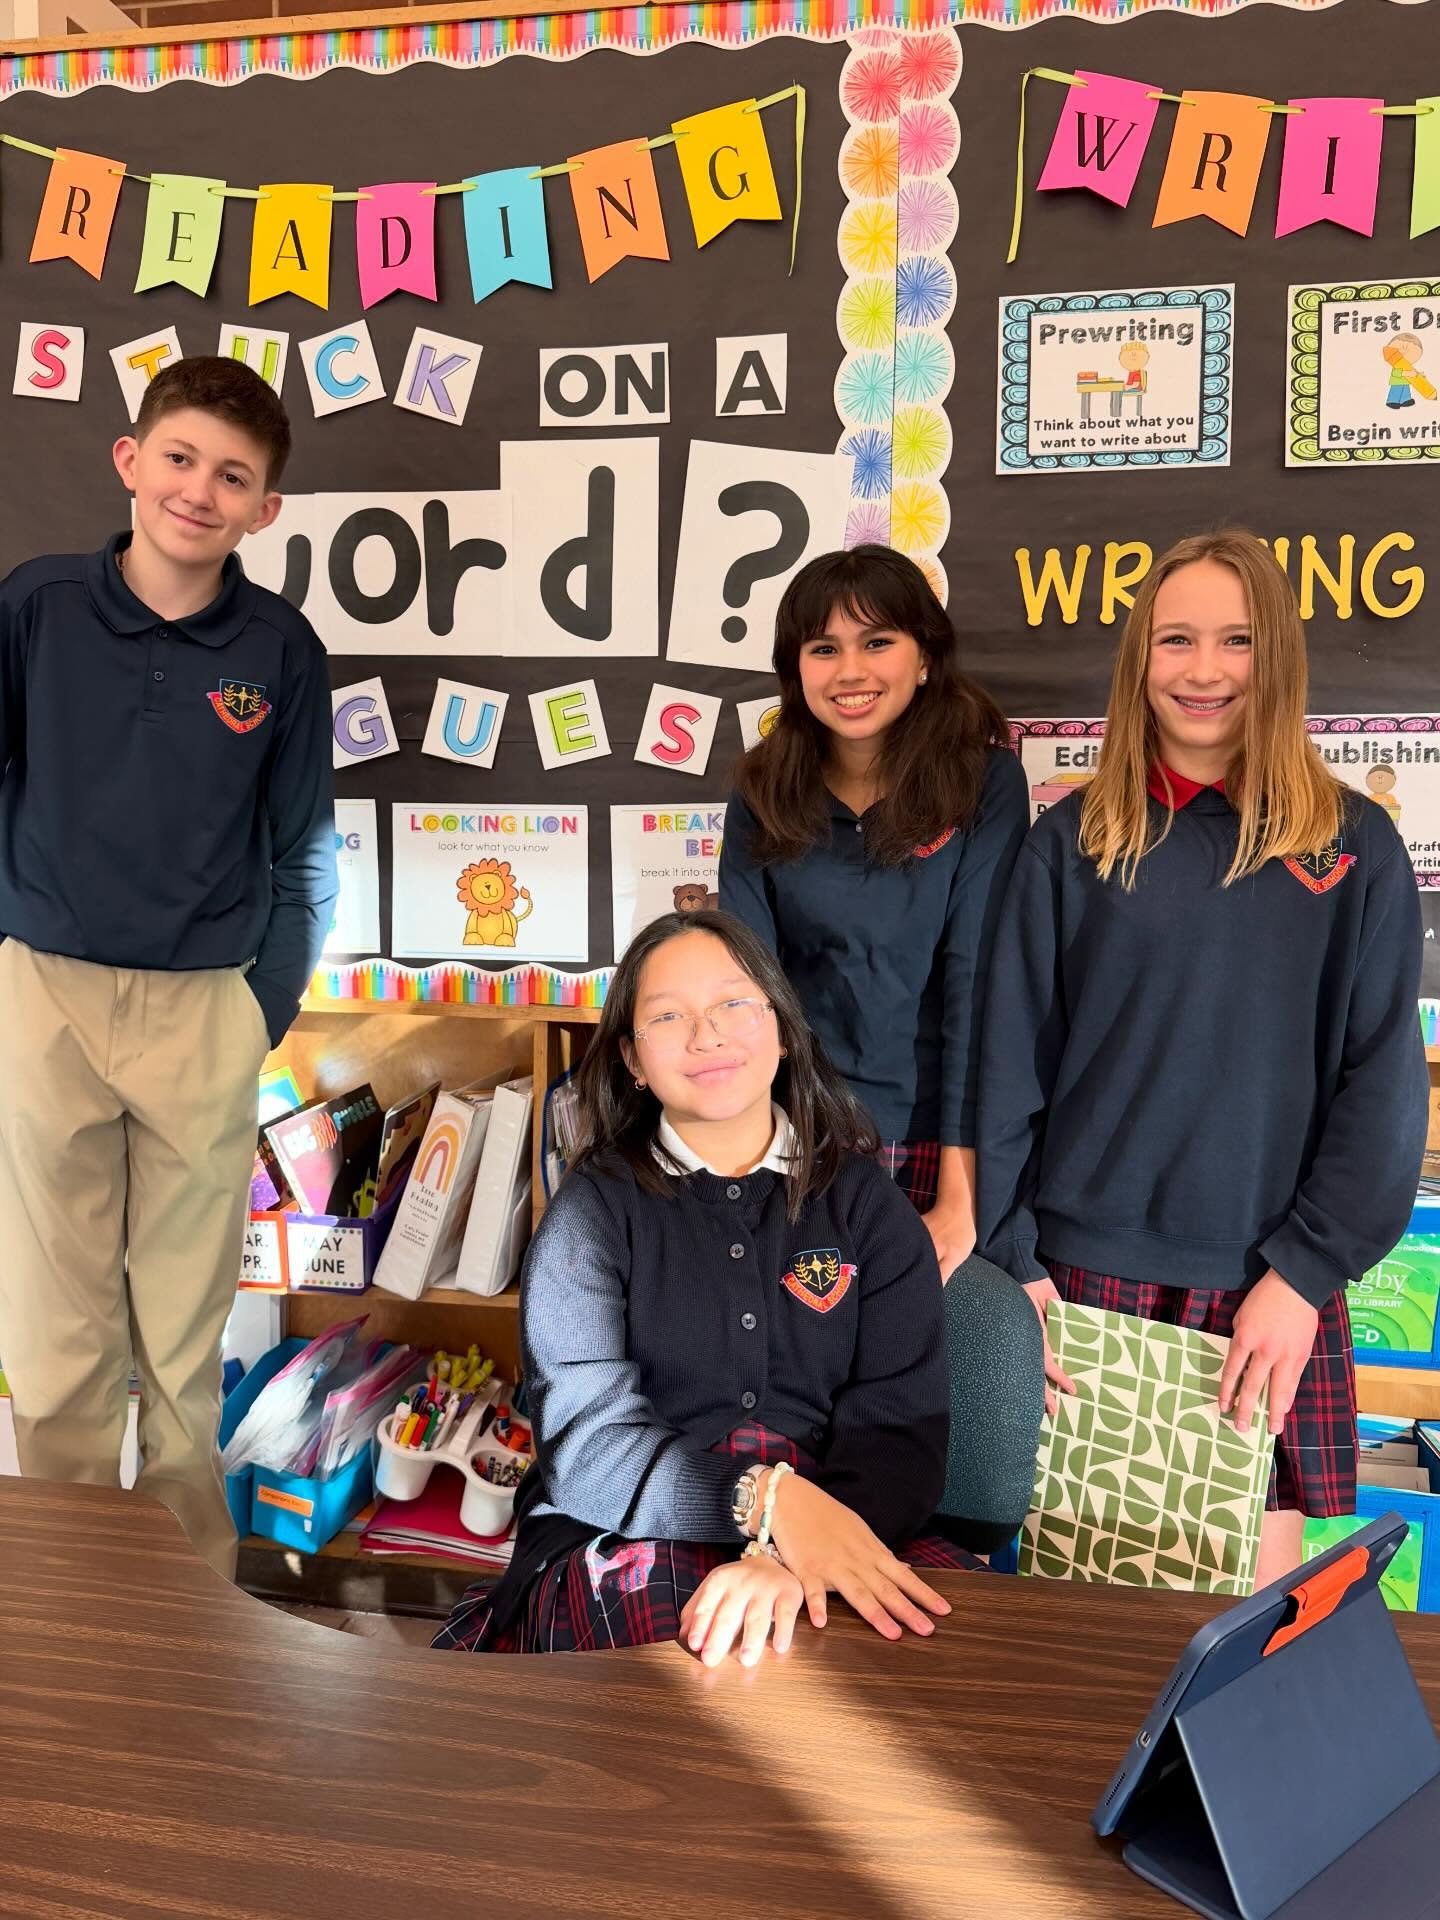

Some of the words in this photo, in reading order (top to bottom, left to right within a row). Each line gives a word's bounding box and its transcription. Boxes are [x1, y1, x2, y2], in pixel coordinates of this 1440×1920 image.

[59, 147, 749, 271] READING
[1039, 317, 1194, 346] Prewriting
[1333, 310, 1402, 335] First
[544, 351, 666, 418] ON
[719, 350, 784, 414] A
[1034, 418, 1074, 431] Think
[1079, 417, 1121, 430] about
[1126, 415, 1162, 428] what
[1167, 416, 1194, 429] you
[1040, 437, 1076, 449] want
[1081, 436, 1096, 447] to
[1101, 434, 1140, 447] write
[1144, 432, 1187, 446] about
[1328, 423, 1392, 446] Begin
[410, 814, 518, 834] LOOKING
[524, 815, 578, 834] LION
[438, 841, 458, 851] look
[461, 842, 473, 851] for
[475, 842, 500, 852] what
[502, 843, 521, 854] you
[523, 843, 549, 853] know
[641, 868, 671, 878] break
[673, 868, 679, 877] it
[682, 868, 700, 877] into
[1322, 863, 1349, 889] SCHOOL
[1363, 1298, 1402, 1308] LIBRARY
